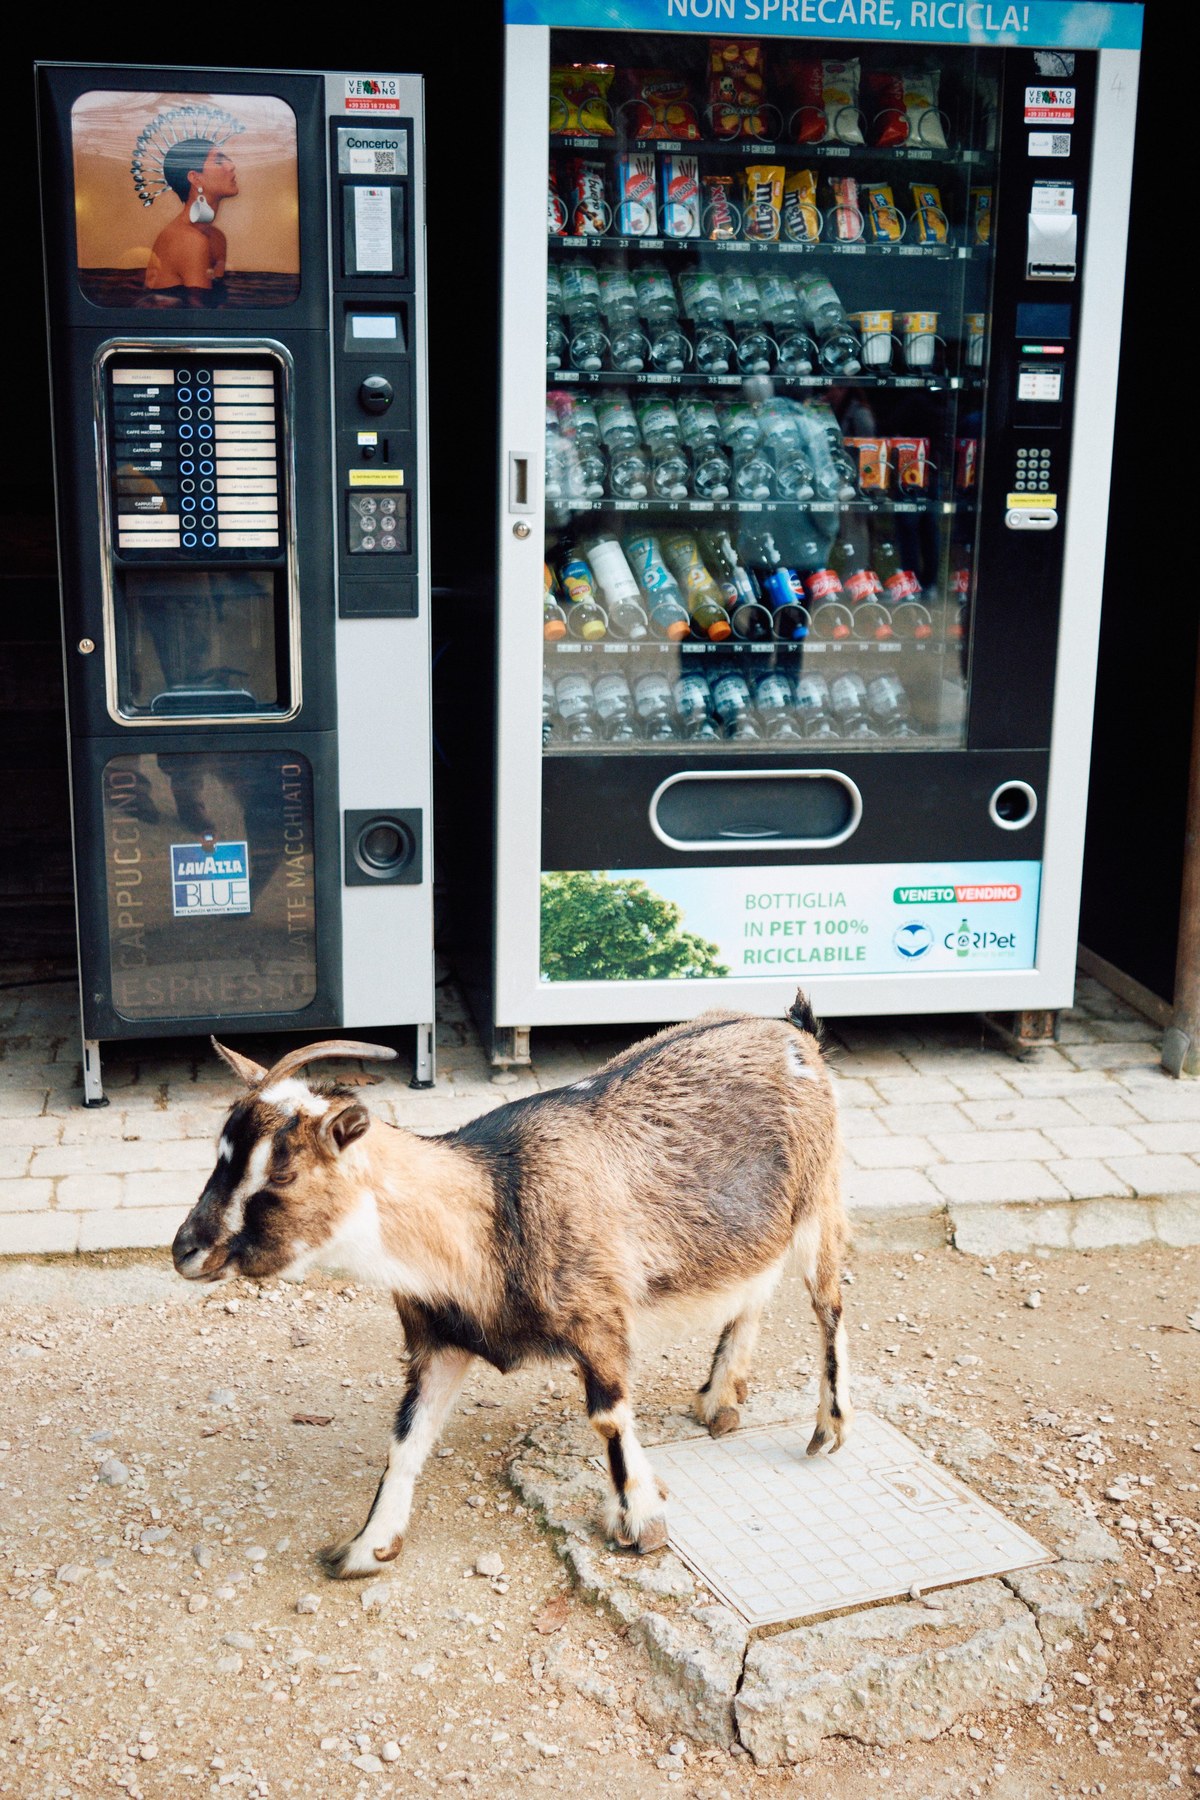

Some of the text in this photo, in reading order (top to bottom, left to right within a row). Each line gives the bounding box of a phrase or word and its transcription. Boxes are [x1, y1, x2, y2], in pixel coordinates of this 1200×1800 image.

[667, 0, 1029, 32] NON SPRECARE, RICICLA!
[346, 137, 398, 149] Concerto
[589, 178, 600, 210] bueno
[626, 176, 654, 201] MIKADO
[669, 178, 696, 201] MIKADO
[281, 764, 306, 888] MACCHIATO
[109, 771, 148, 969] CAPPUCCINO
[178, 857, 243, 875] LAVAZZA
[175, 881, 248, 907] BLUE
[745, 892, 847, 910] BOTTIGLIA
[899, 886, 1017, 902] VENETO VENDING
[287, 895, 309, 967] LATTE
[744, 919, 869, 938] IN PET 100%
[743, 946, 867, 964] RICICLABILE
[121, 970, 309, 1008] ESPRESSO
